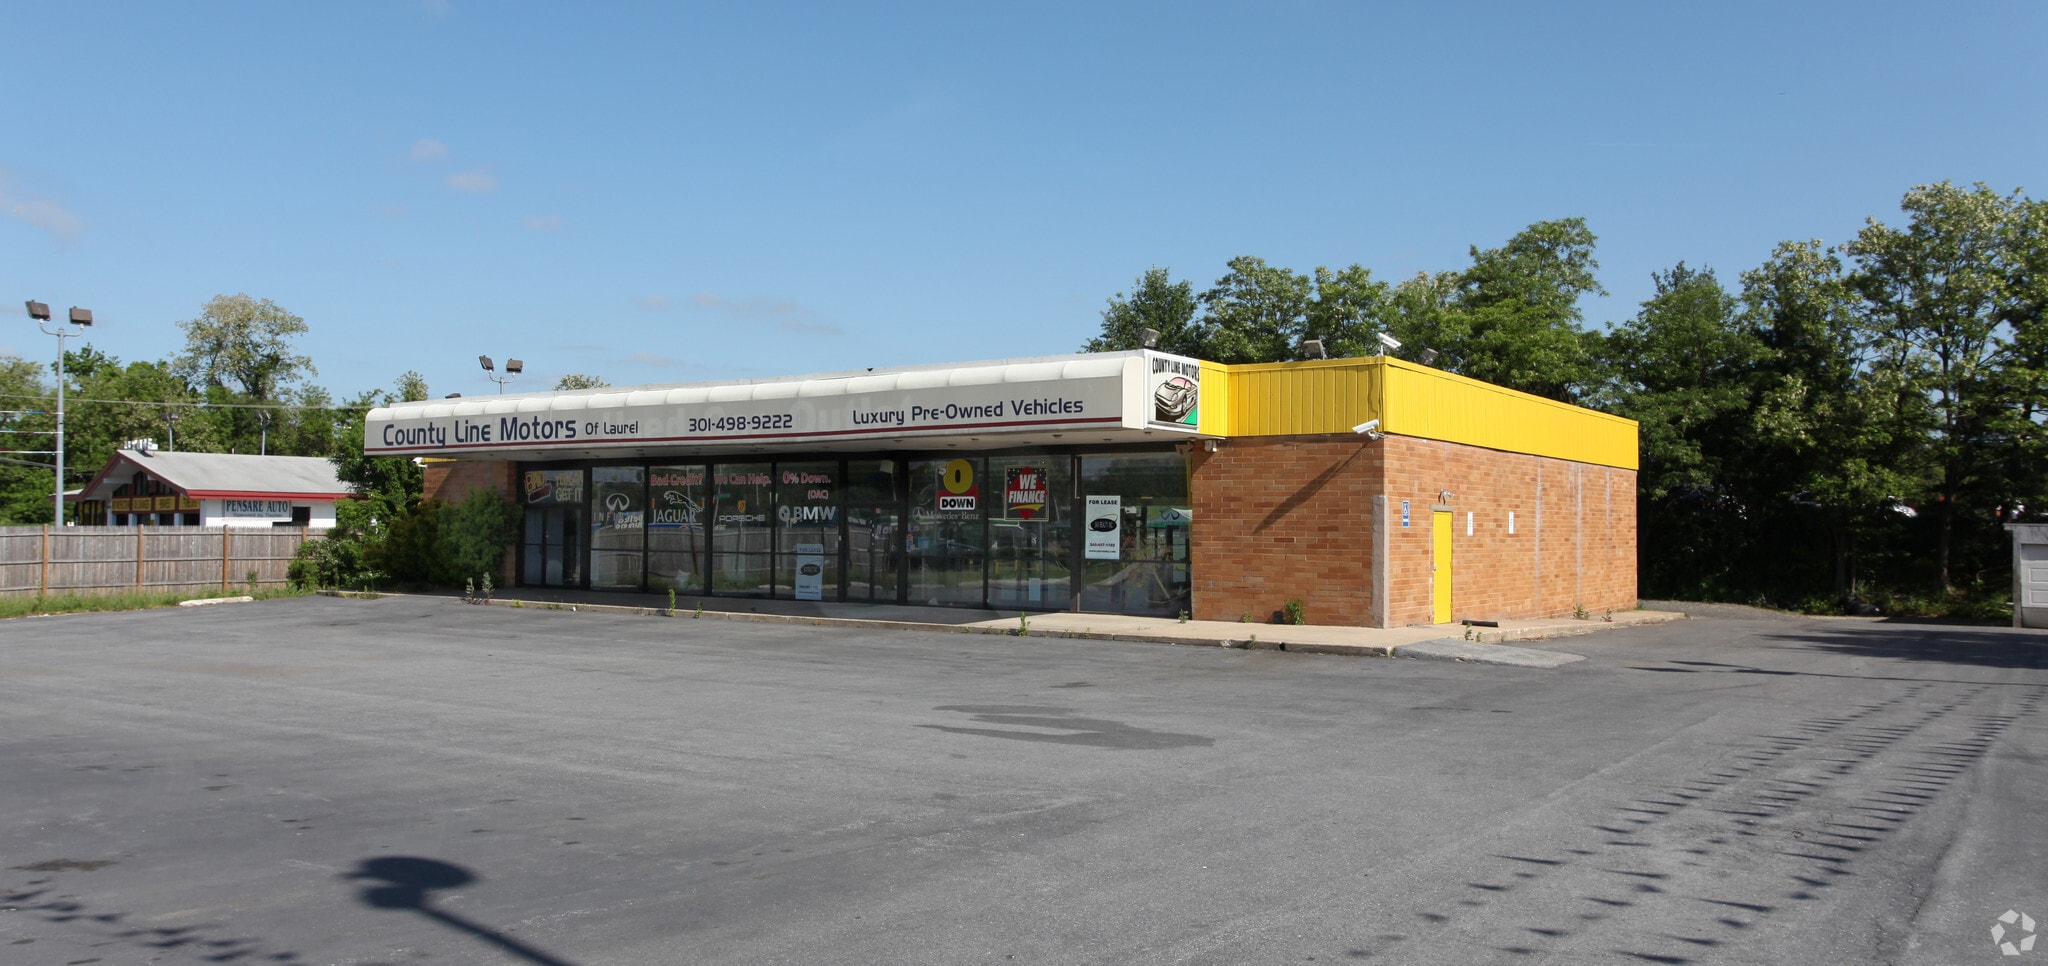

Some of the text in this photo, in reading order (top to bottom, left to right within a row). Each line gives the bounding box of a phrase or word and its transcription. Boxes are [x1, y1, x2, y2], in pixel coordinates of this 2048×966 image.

[1152, 357, 1170, 374] COUNTY
[1171, 360, 1181, 374] LINE
[853, 409, 905, 425] Luxury
[911, 402, 1003, 421] Pre-Owned
[1011, 398, 1084, 416] Vehicles
[689, 414, 793, 433] 301-498-9222
[382, 422, 445, 448] County
[455, 419, 491, 444] Line
[500, 416, 577, 441] Motors
[585, 422, 599, 435] Of
[603, 420, 639, 434] Laurel
[728, 473, 747, 485] Can
[748, 473, 772, 487] Help.
[782, 471, 831, 484] 0% Down.
[1019, 474, 1038, 490] WE
[807, 490, 829, 500] (OAC)
[1008, 491, 1046, 504] FINANCE
[226, 500, 289, 513] PENSARE AUTO
[941, 498, 974, 509] DOWN
[652, 509, 697, 524] JAGUAR
[718, 514, 766, 522] PORSCHE
[793, 506, 837, 520] BMW
